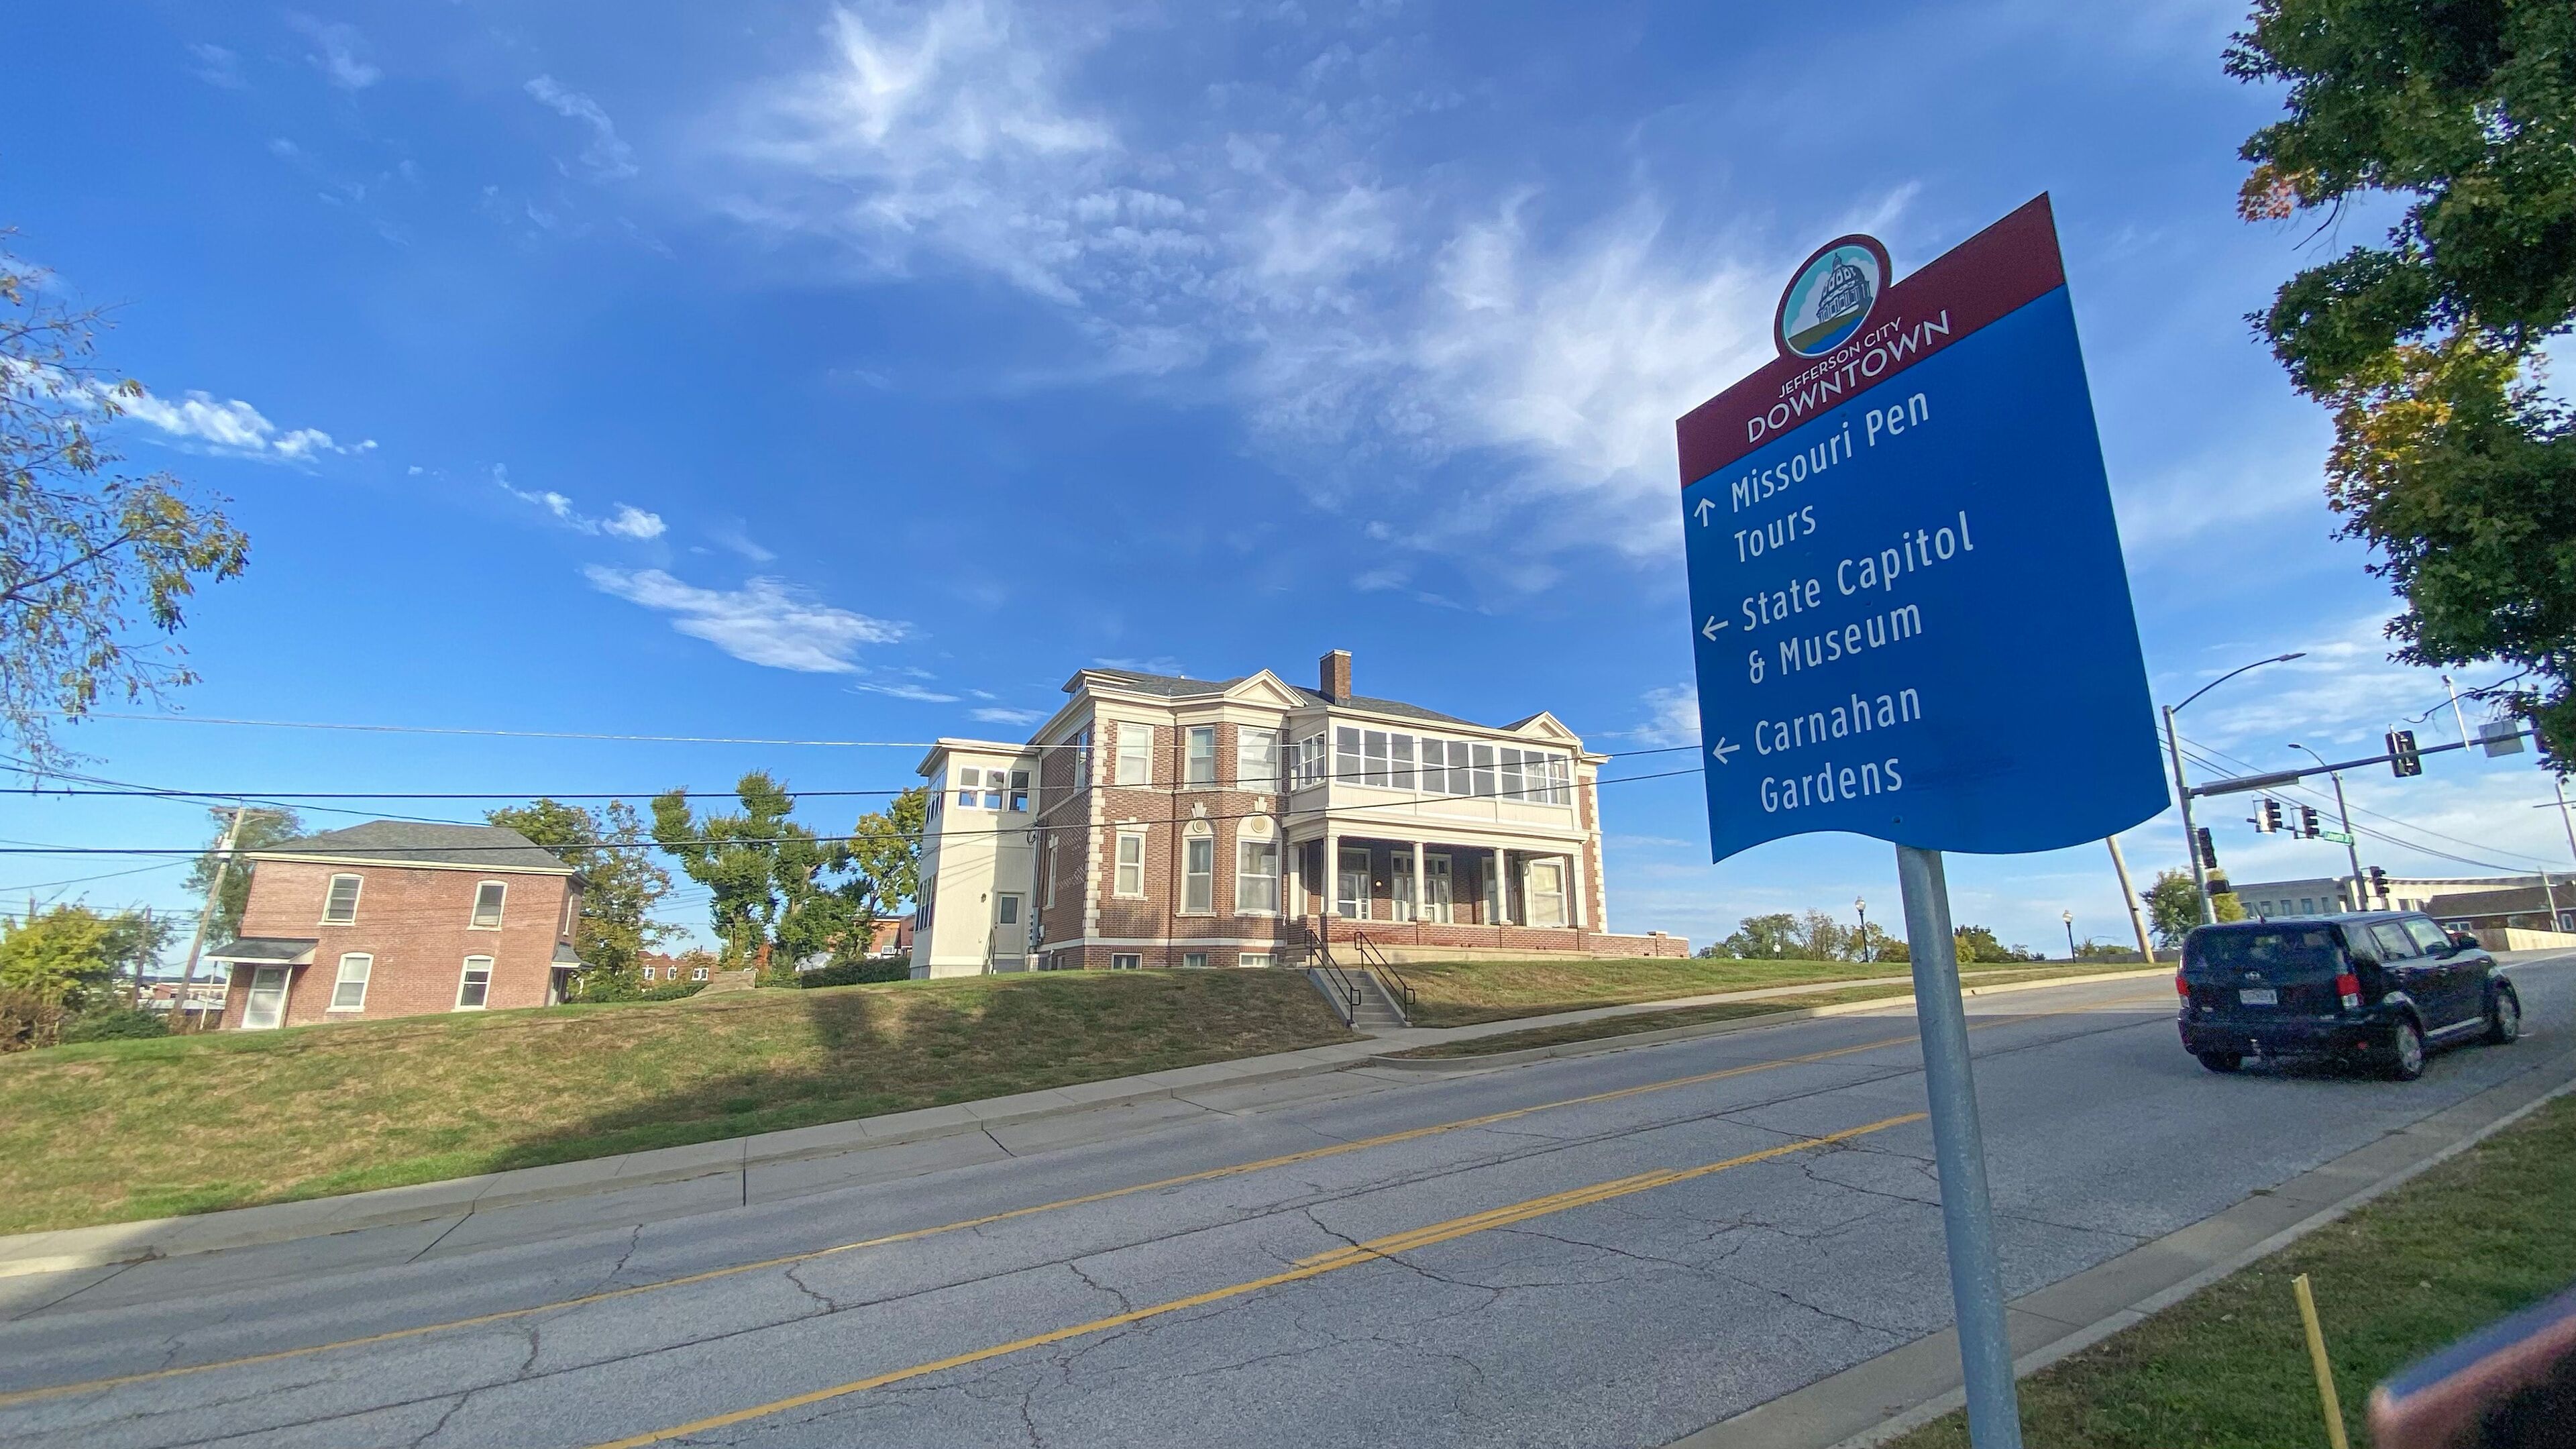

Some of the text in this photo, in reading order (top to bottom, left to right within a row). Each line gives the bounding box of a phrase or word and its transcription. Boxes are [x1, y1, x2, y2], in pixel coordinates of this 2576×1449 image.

[1747, 309, 1950, 443] DOWNTOWN
[1778, 317, 1901, 398] JEFFERSON CITY
[1731, 392, 1929, 513] Missouri Pen
[1733, 505, 1816, 562] Tours
[1742, 511, 1974, 631] State Capitol
[1749, 604, 1922, 684] & Museum
[1756, 688, 1921, 755] Carnahan
[1761, 758, 1902, 812] Gardens
